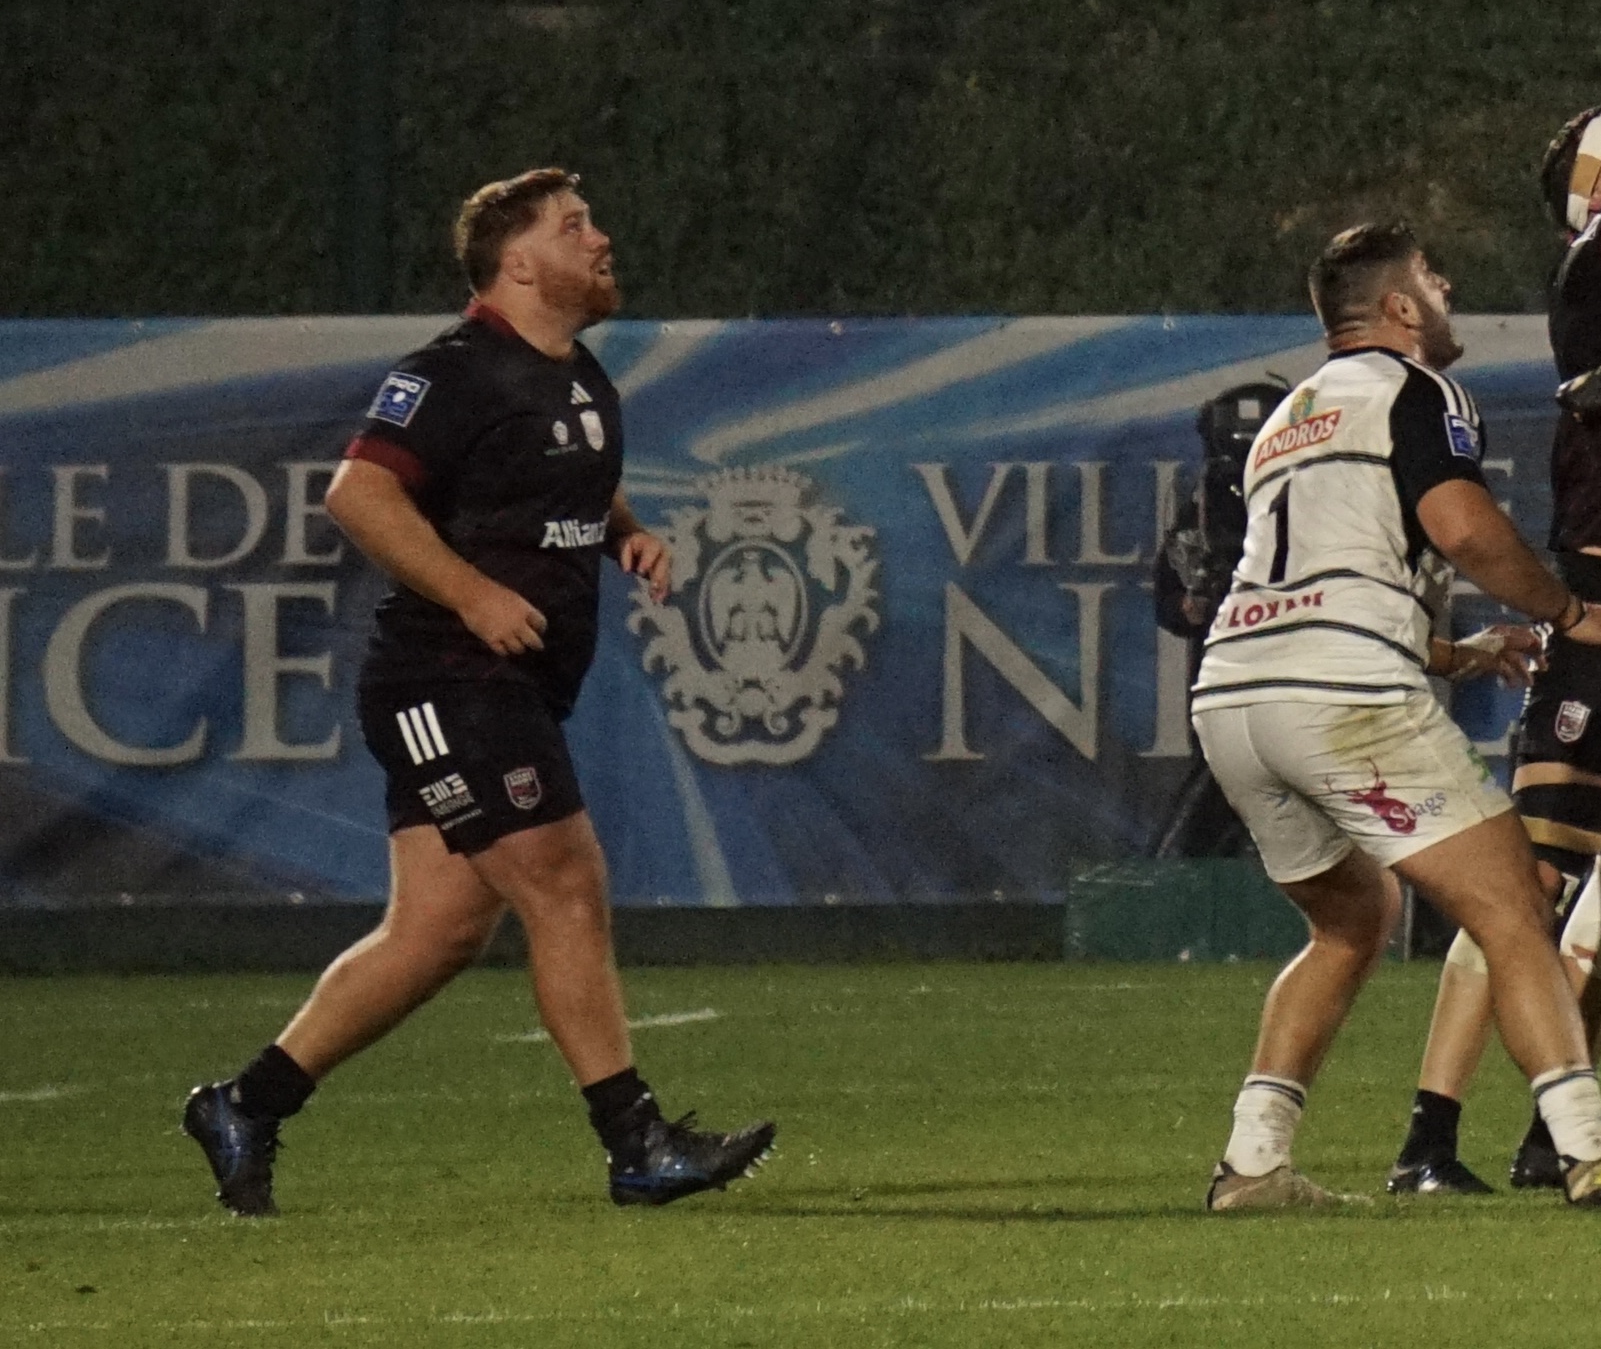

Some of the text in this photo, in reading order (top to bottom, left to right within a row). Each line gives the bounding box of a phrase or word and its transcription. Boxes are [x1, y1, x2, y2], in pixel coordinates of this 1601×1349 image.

[1256, 412, 1339, 464] ANDROS
[155, 462, 344, 569] DE
[1268, 479, 1291, 584] 1
[1390, 792, 1447, 829] Stags
